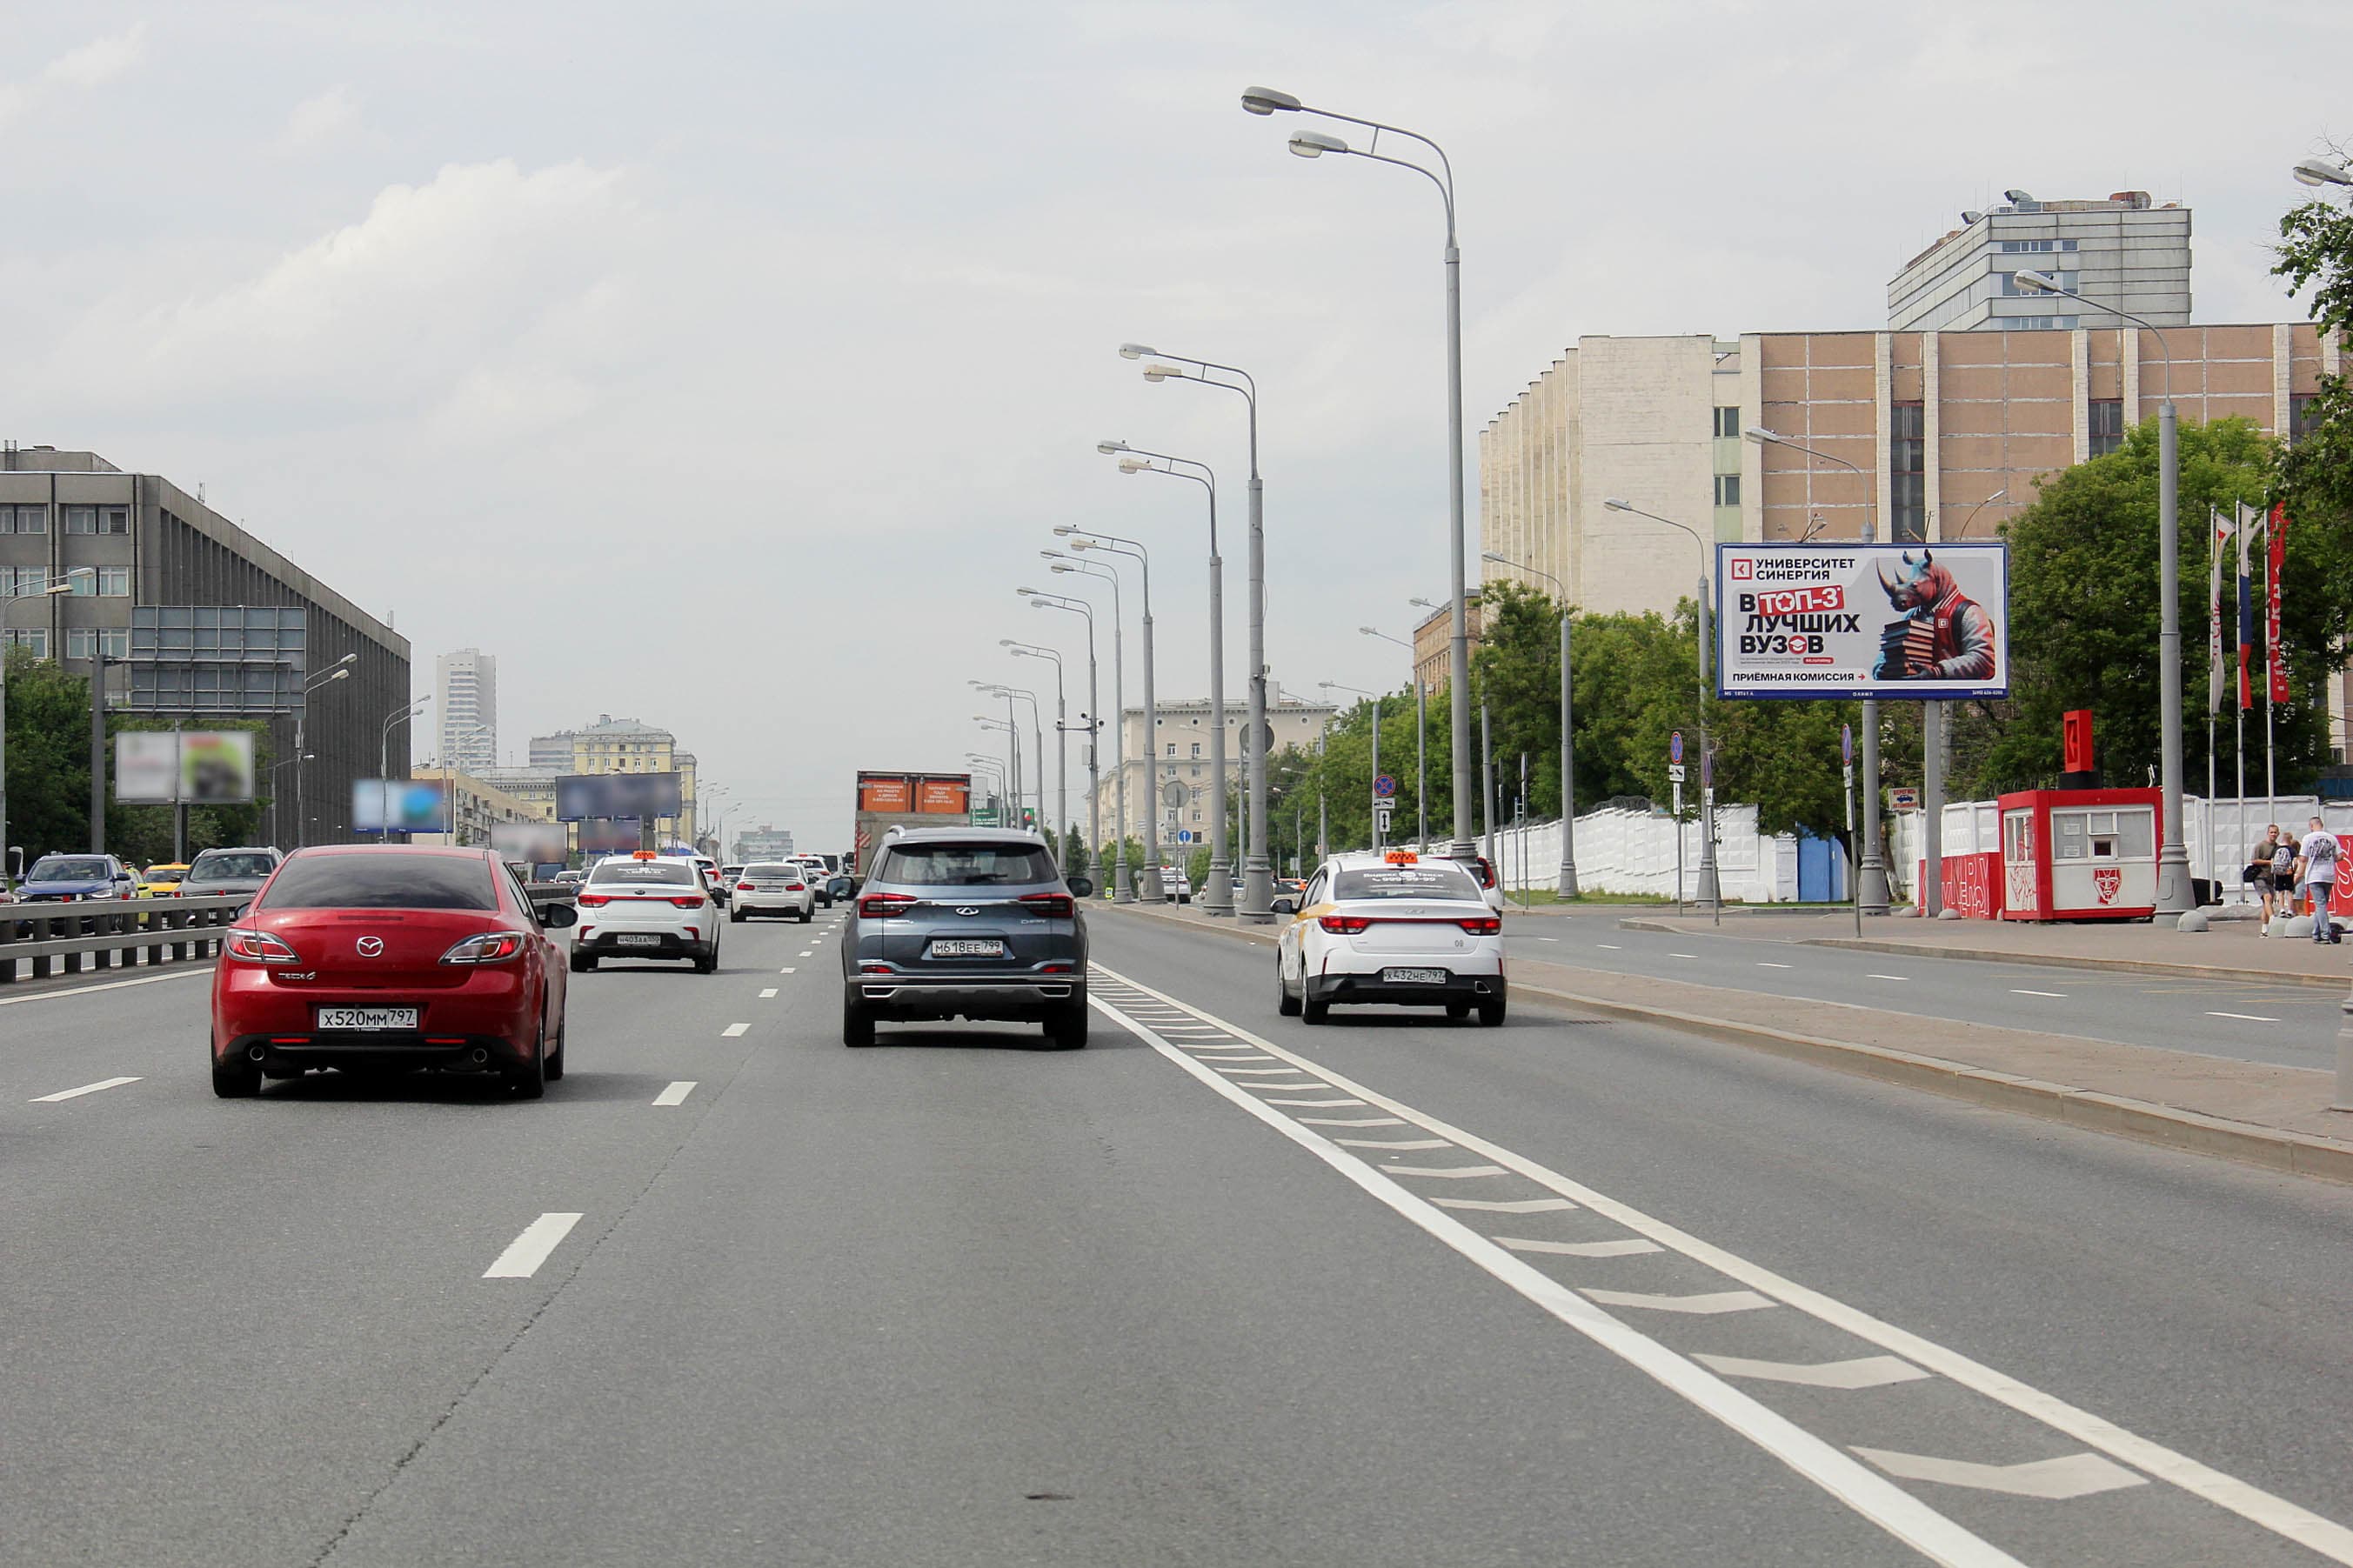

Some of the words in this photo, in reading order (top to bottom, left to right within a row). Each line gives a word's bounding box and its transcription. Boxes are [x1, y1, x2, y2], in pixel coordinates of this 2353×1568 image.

[1756, 558, 1855, 569] УНИВЕРСИТЕТ
[1756, 570, 1830, 580] СИНЕРГИЯ
[1740, 594, 1755, 612] В
[1746, 614, 1861, 632] ЛУЧШИХ
[1733, 672, 1792, 682] ПРИЁМНАЯ
[1794, 672, 1855, 682] КОМИССИЯ
[324, 1011, 387, 1026] Х520ММ
[389, 1010, 413, 1022] 797
